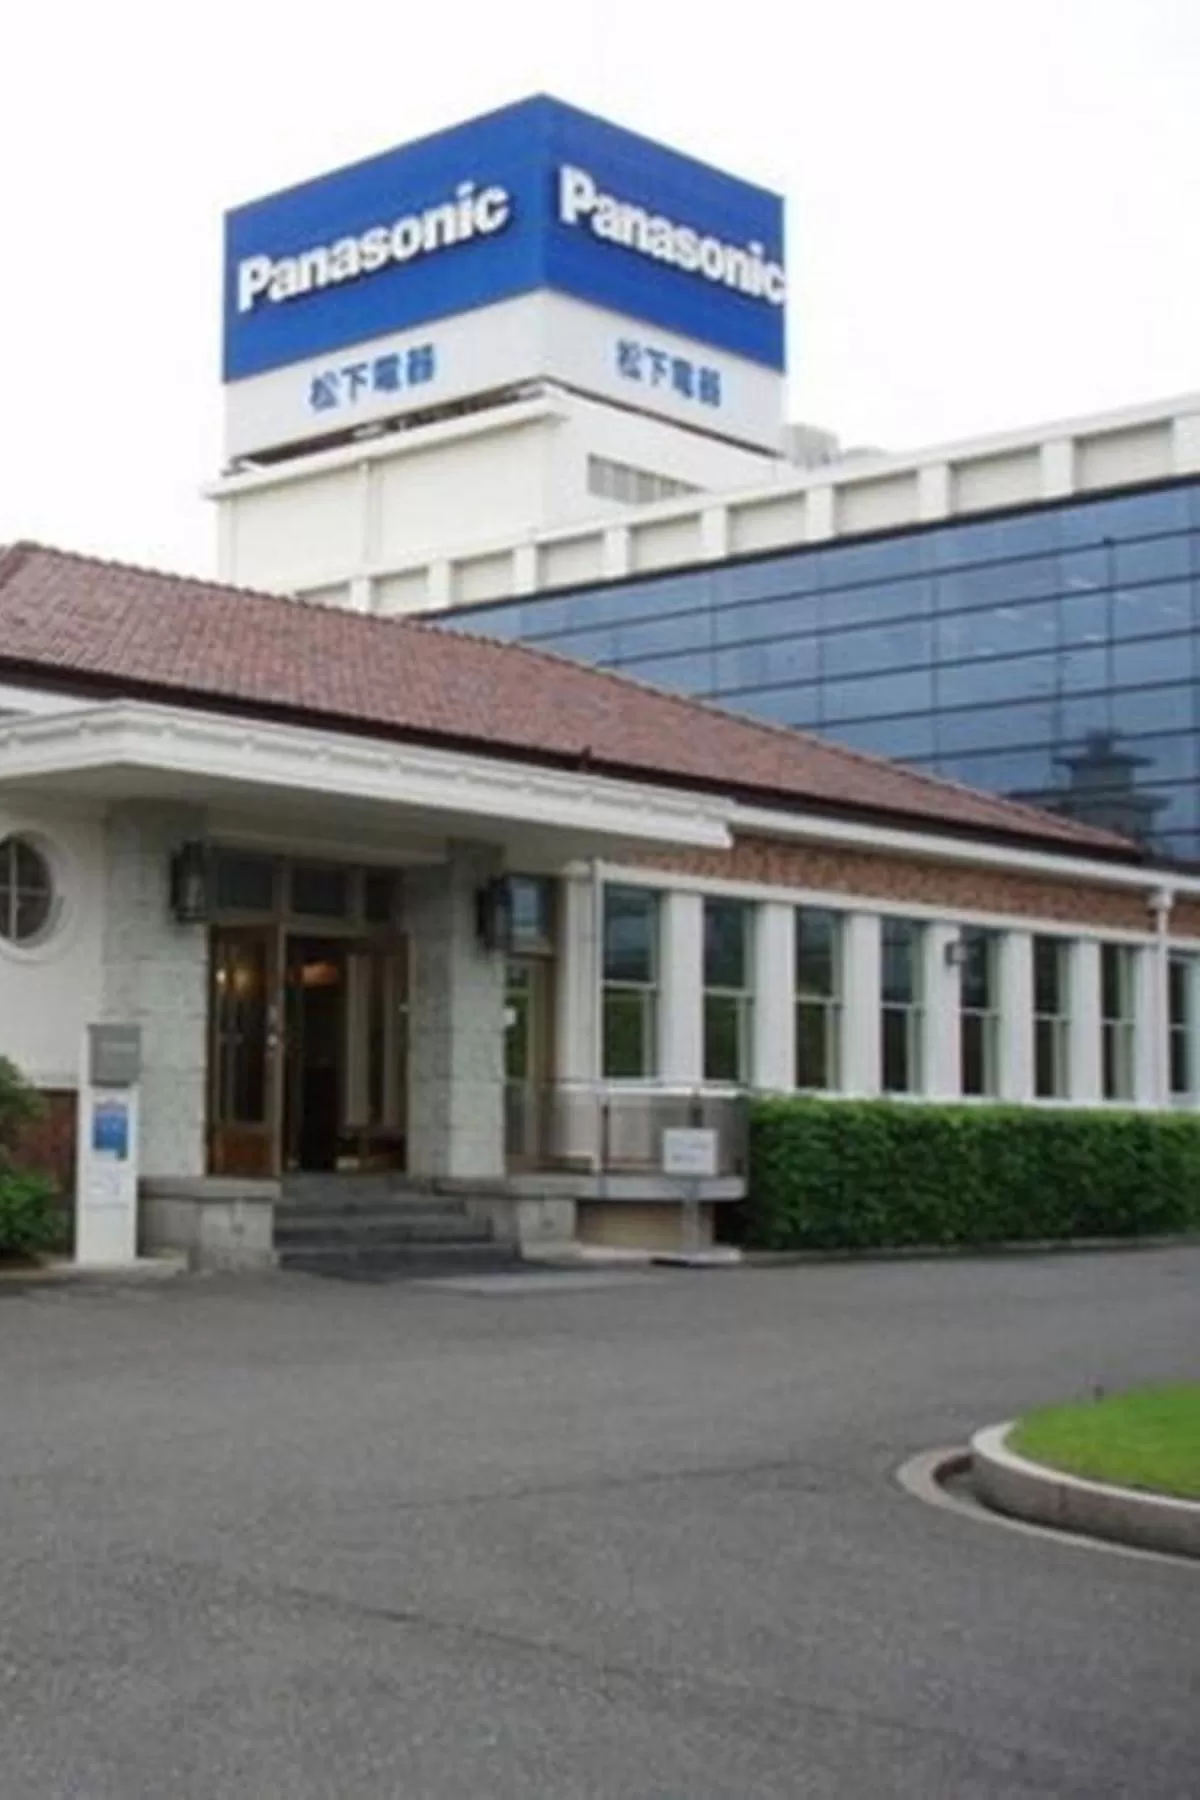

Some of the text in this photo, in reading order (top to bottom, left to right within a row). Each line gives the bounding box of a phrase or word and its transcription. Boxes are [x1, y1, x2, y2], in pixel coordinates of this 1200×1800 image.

[237, 181, 509, 312] Panasonic
[557, 164, 786, 303] Panasonic
[308, 343, 438, 412] 松下電器
[616, 339, 722, 408] 松下電器
